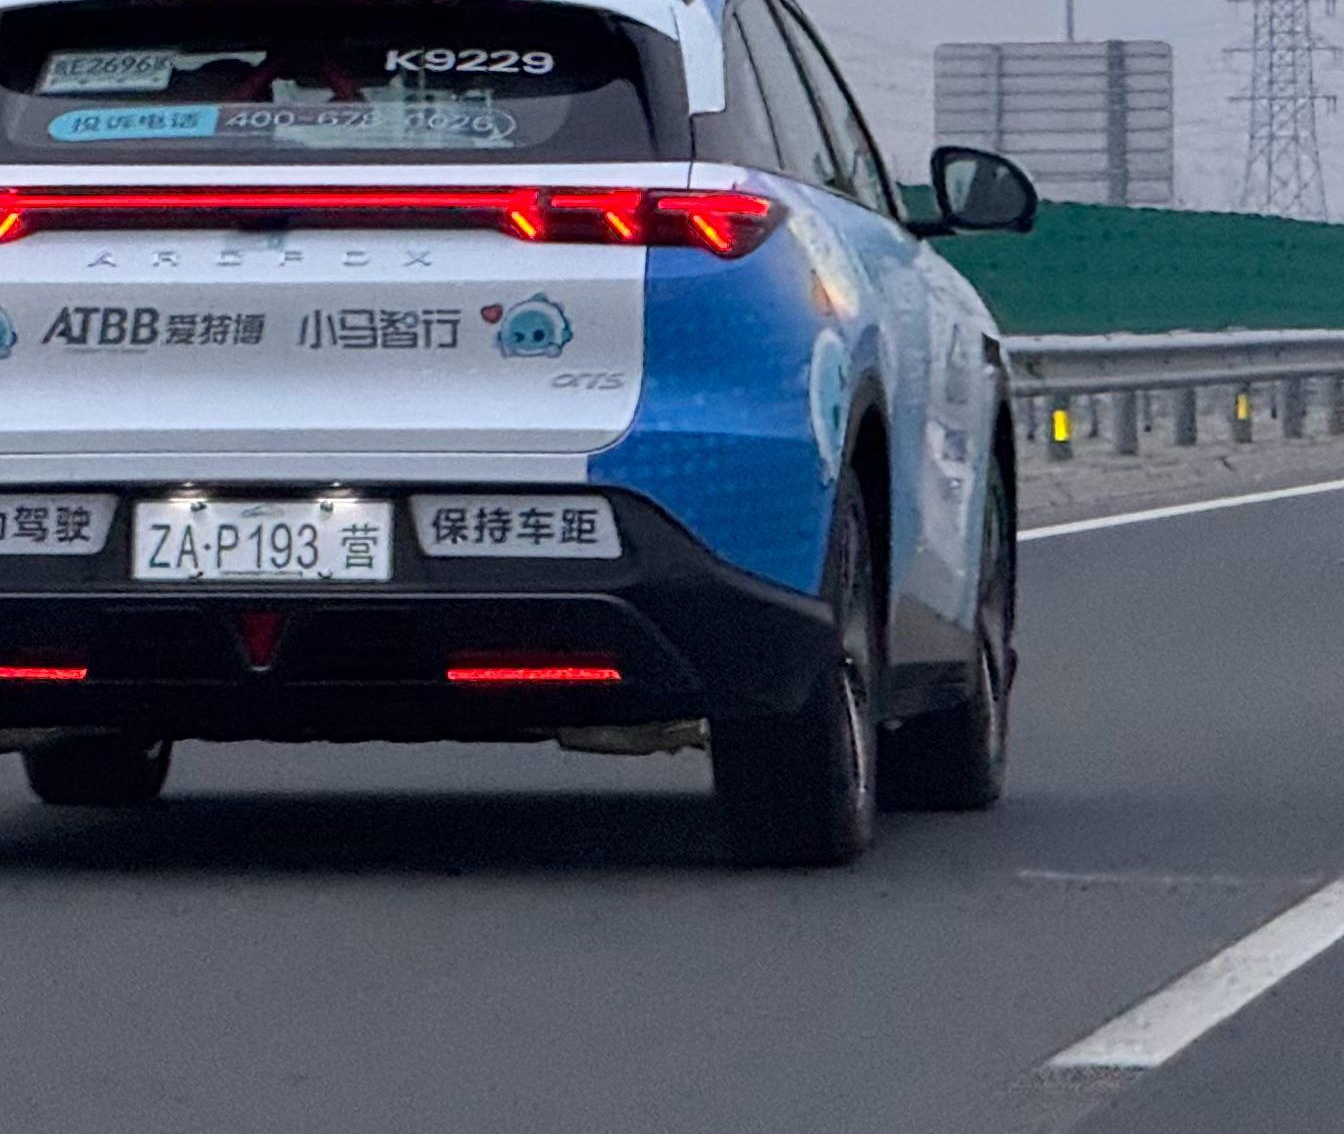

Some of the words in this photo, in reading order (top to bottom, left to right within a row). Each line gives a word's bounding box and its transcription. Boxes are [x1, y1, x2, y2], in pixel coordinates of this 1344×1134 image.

[385, 49, 553, 74] K9229
[42, 306, 160, 346] ATBB
[165, 313, 265, 346] 爱特博
[298, 308, 461, 349] 小马智行
[432, 507, 599, 544] 保持车距
[341, 523, 379, 570] 营
